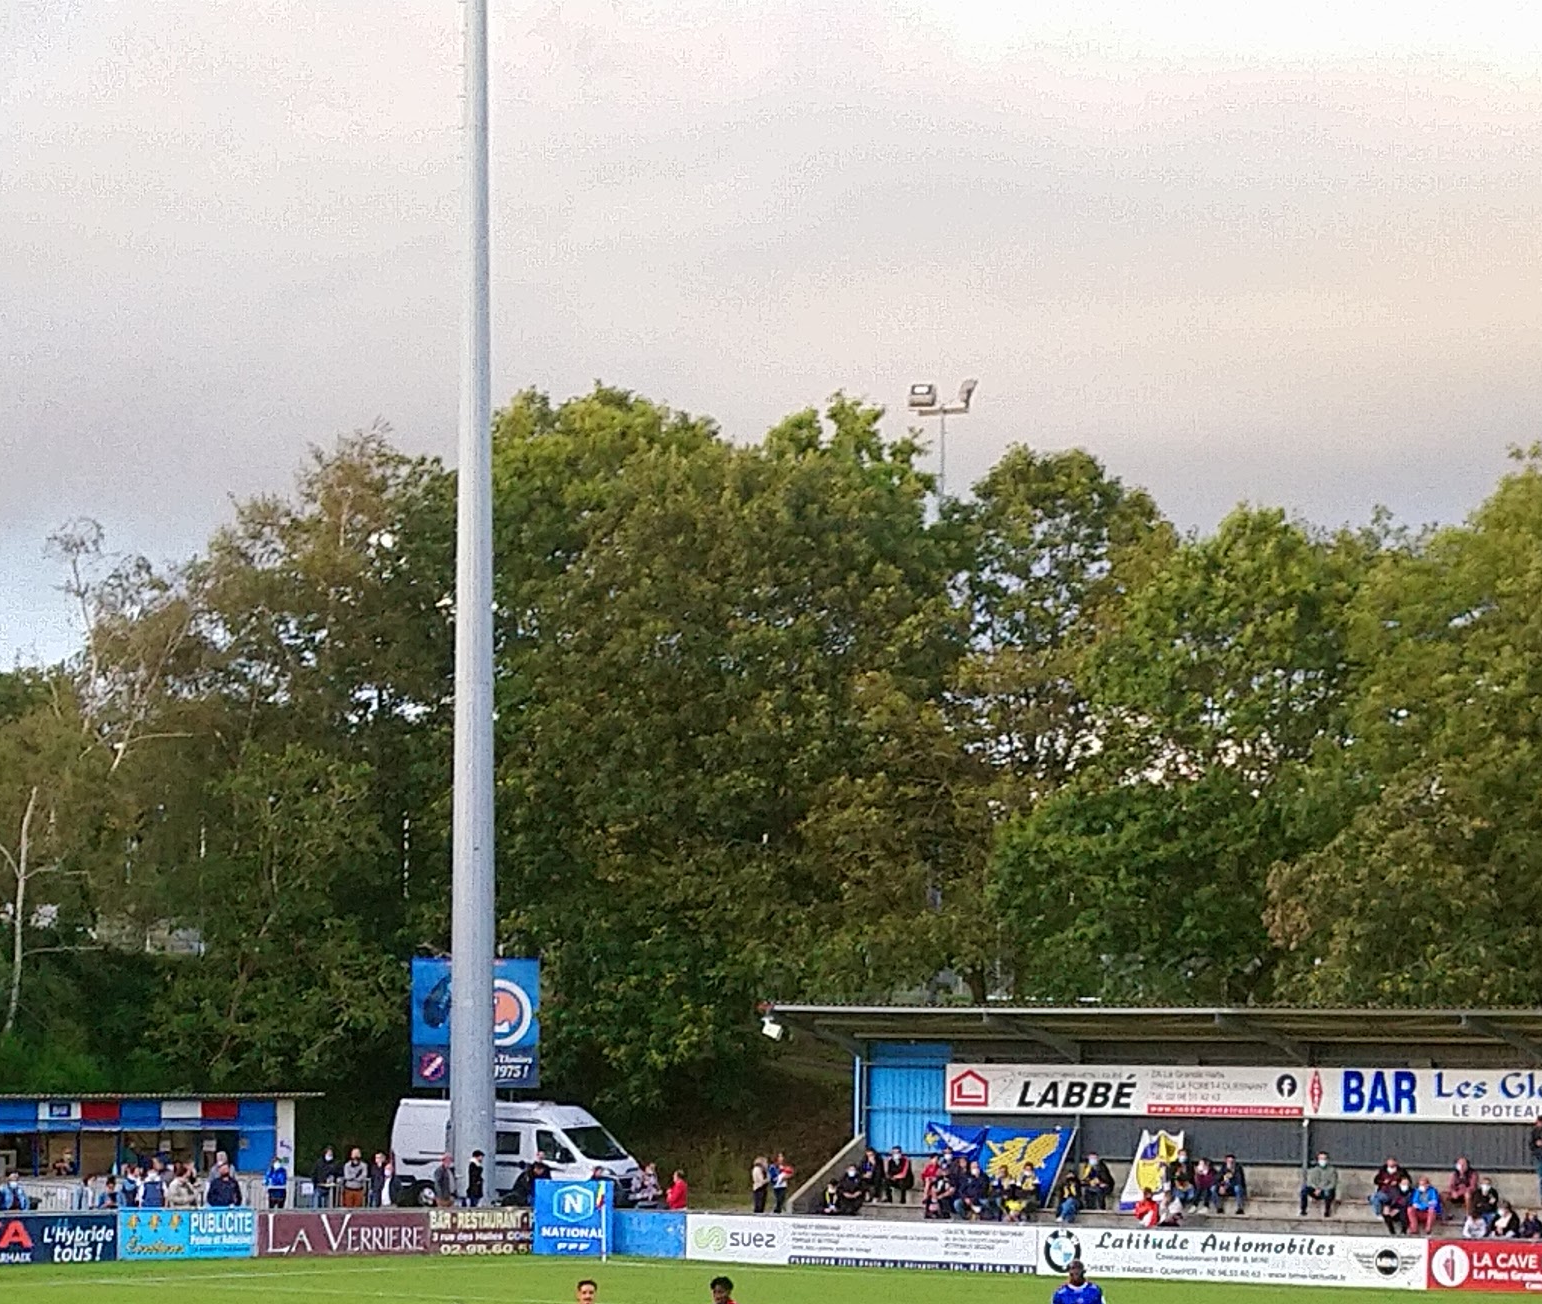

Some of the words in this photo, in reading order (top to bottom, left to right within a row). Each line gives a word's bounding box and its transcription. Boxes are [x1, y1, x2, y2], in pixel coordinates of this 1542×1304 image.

[494, 1064, 520, 1078] 1975
[1016, 1073, 1137, 1109] LABBÉ
[1343, 1071, 1417, 1114] BAR
[1435, 1072, 1489, 1099] Les
[1452, 1104, 1470, 1118] LE
[563, 1194, 583, 1214] N
[429, 1210, 451, 1229] BAR
[459, 1210, 523, 1229] RESTAURANT
[43, 1223, 115, 1244] L'Hybride
[267, 1213, 314, 1254] LA
[321, 1213, 426, 1251] VERRIERE
[540, 1226, 604, 1238] NATIONAL
[729, 1231, 776, 1249] suez
[53, 1242, 93, 1263] tous
[94, 1242, 103, 1261] !
[1095, 1231, 1190, 1250] Latitude
[1200, 1233, 1336, 1256] Automobiles
[1473, 1252, 1492, 1268] LA
[1496, 1252, 1539, 1269] CAVE
[1473, 1269, 1485, 1280] La
[1487, 1269, 1509, 1280] Plus
